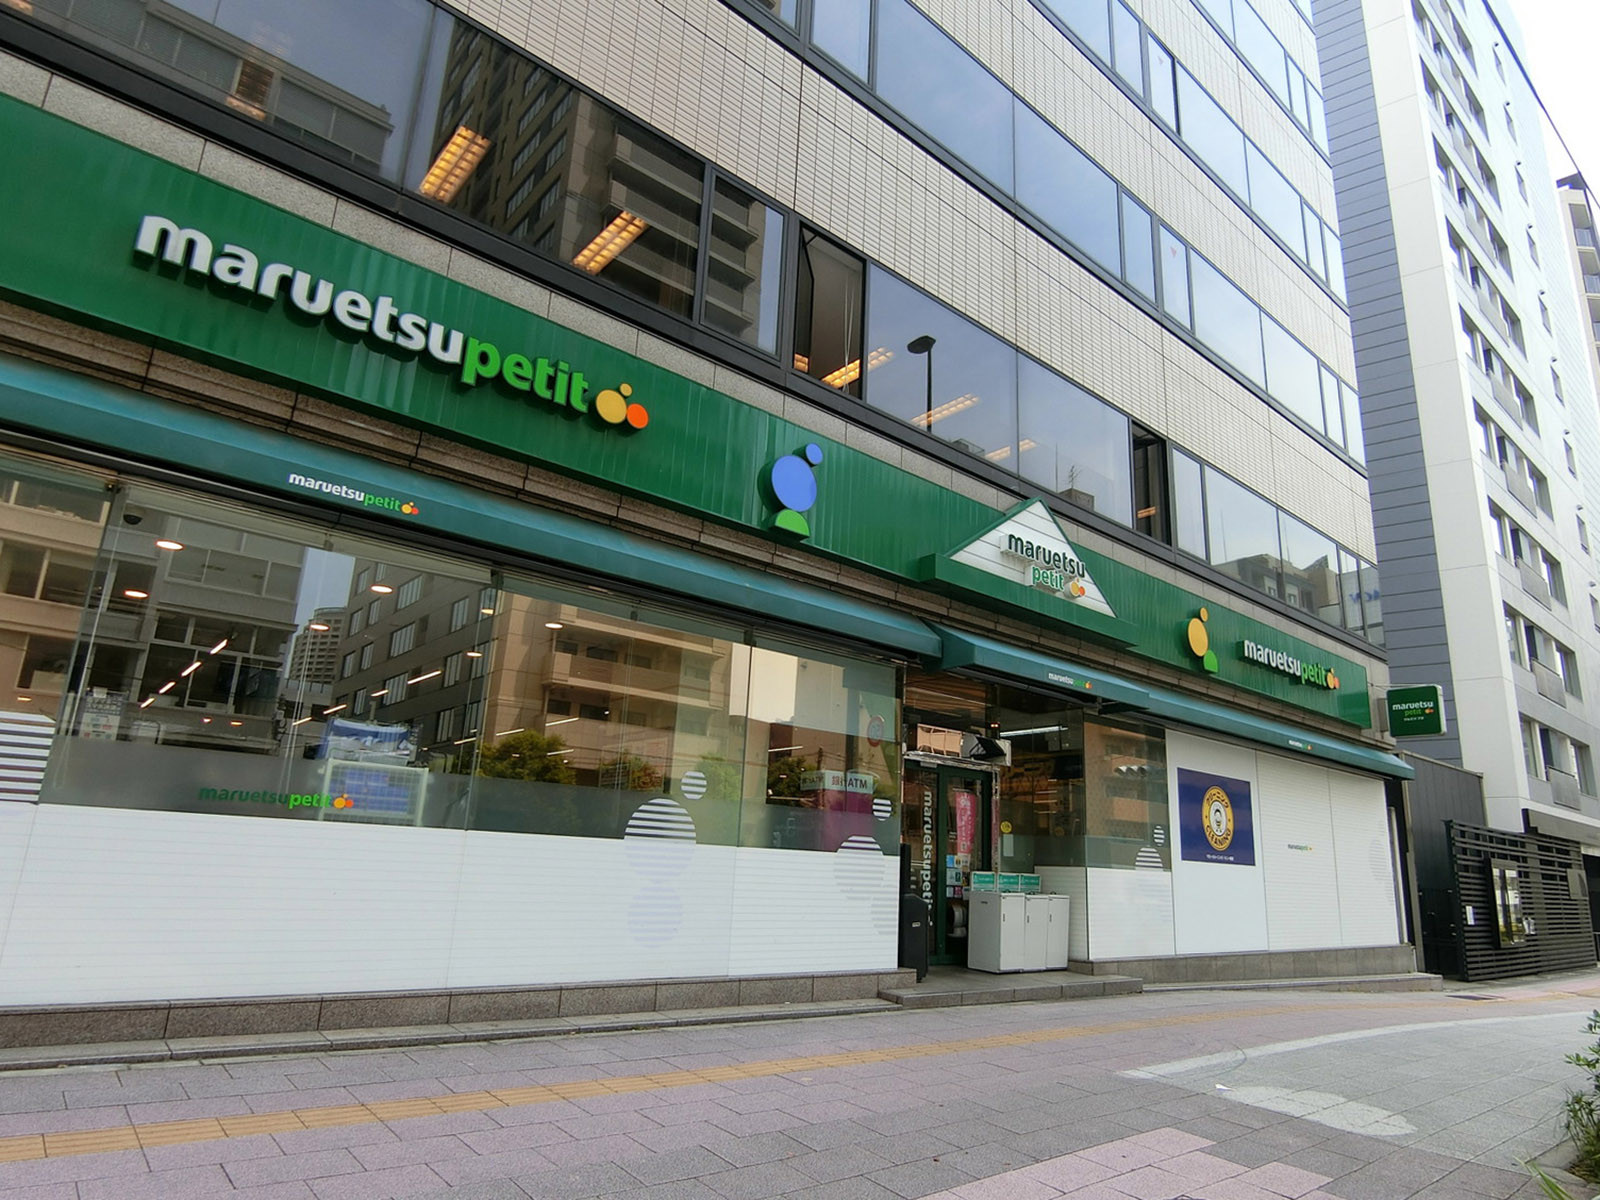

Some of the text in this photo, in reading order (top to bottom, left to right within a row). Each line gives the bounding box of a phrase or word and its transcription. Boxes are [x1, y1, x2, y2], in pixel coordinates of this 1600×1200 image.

[1008, 533, 1085, 578] maruetsu
[1032, 566, 1064, 591] petit
[1392, 701, 1434, 710] maruetsu
[1206, 824, 1232, 846] CLEANING
[920, 791, 934, 910] maruetsupeti
